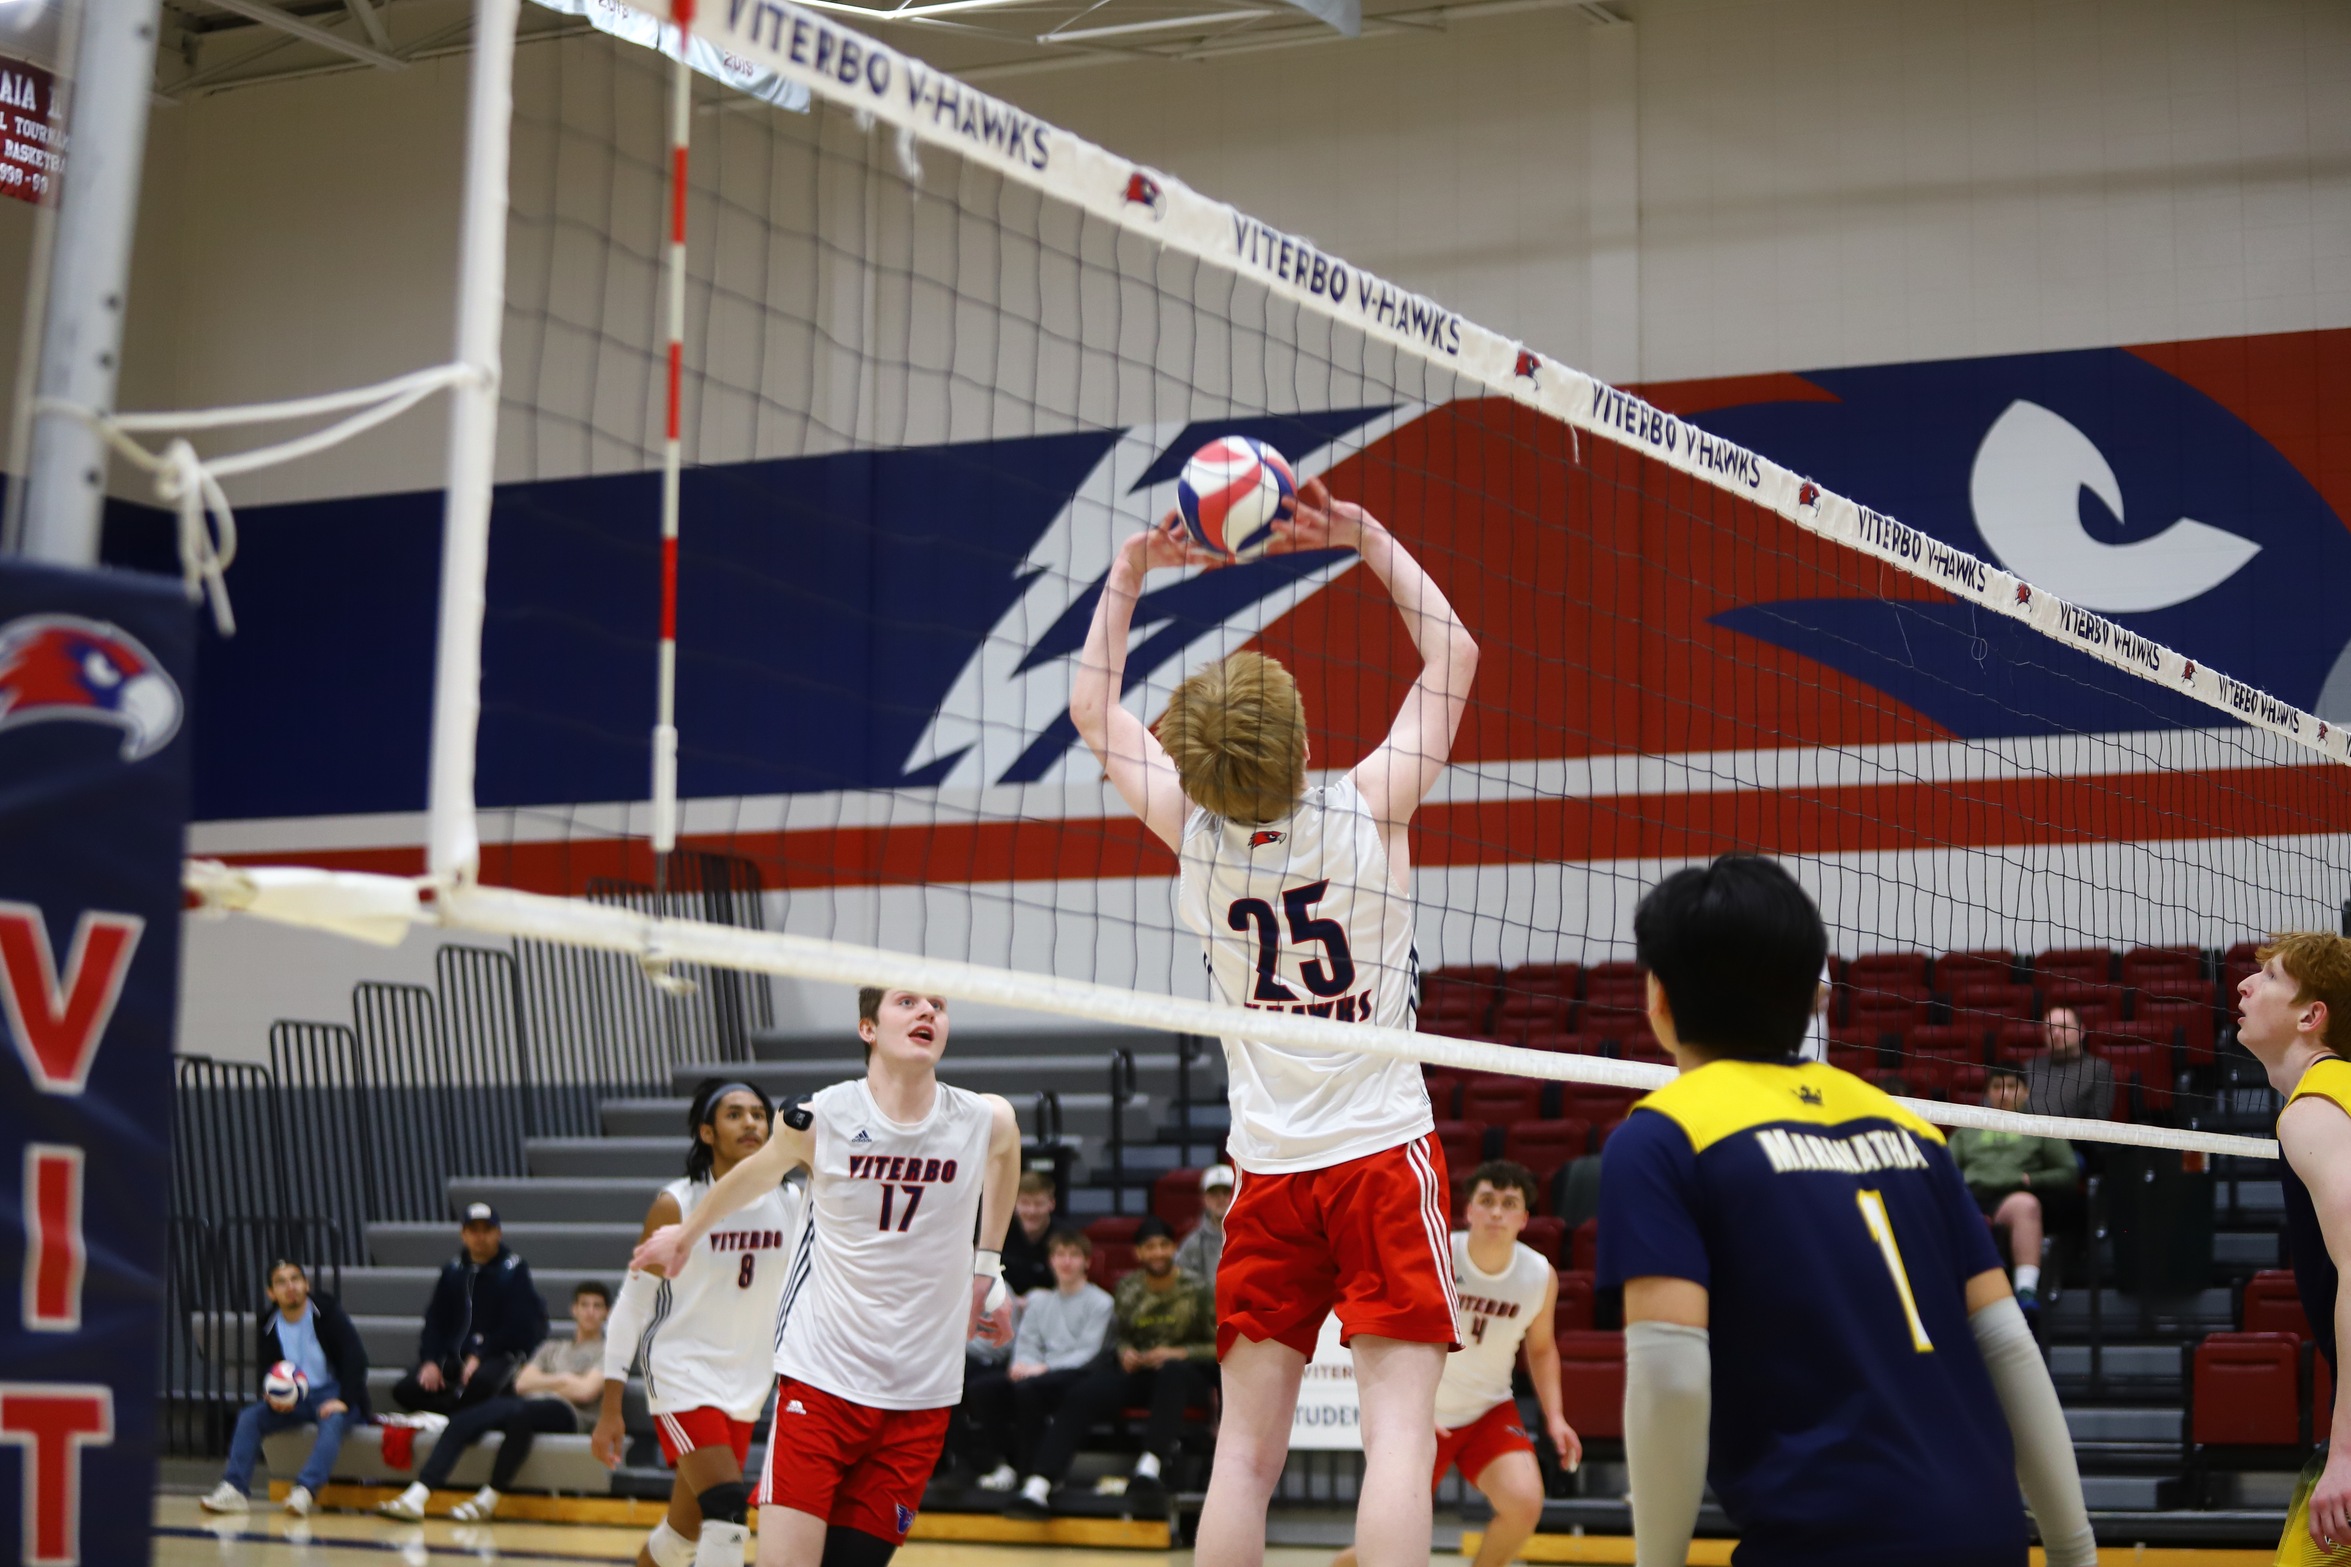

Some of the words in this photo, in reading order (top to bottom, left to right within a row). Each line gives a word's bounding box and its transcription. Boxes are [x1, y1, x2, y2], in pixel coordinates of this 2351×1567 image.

[728, 0, 890, 96] VITERBO
[907, 64, 1051, 171] V-HAWKS
[1233, 213, 1348, 305] VITERBO
[1358, 270, 1461, 356] V-HAWKS
[1592, 380, 1676, 451] VITERBO
[1685, 429, 1761, 488] V-HAWKS
[1858, 505, 1922, 563] VITERBO
[1926, 537, 1986, 592] V-HAWKS
[2060, 601, 2109, 647] VITERBO
[2113, 625, 2160, 671] V-HAWKS
[1228, 878, 1355, 1001] 25
[849, 1155, 958, 1183] VITERBO
[710, 1230, 783, 1252] VITERBO
[878, 1184, 925, 1232] 17
[738, 1253, 755, 1289] 8
[1458, 1293, 1521, 1318] ITERBO
[1856, 1189, 1934, 1353] 1
[1471, 1315, 1488, 1345] 4
